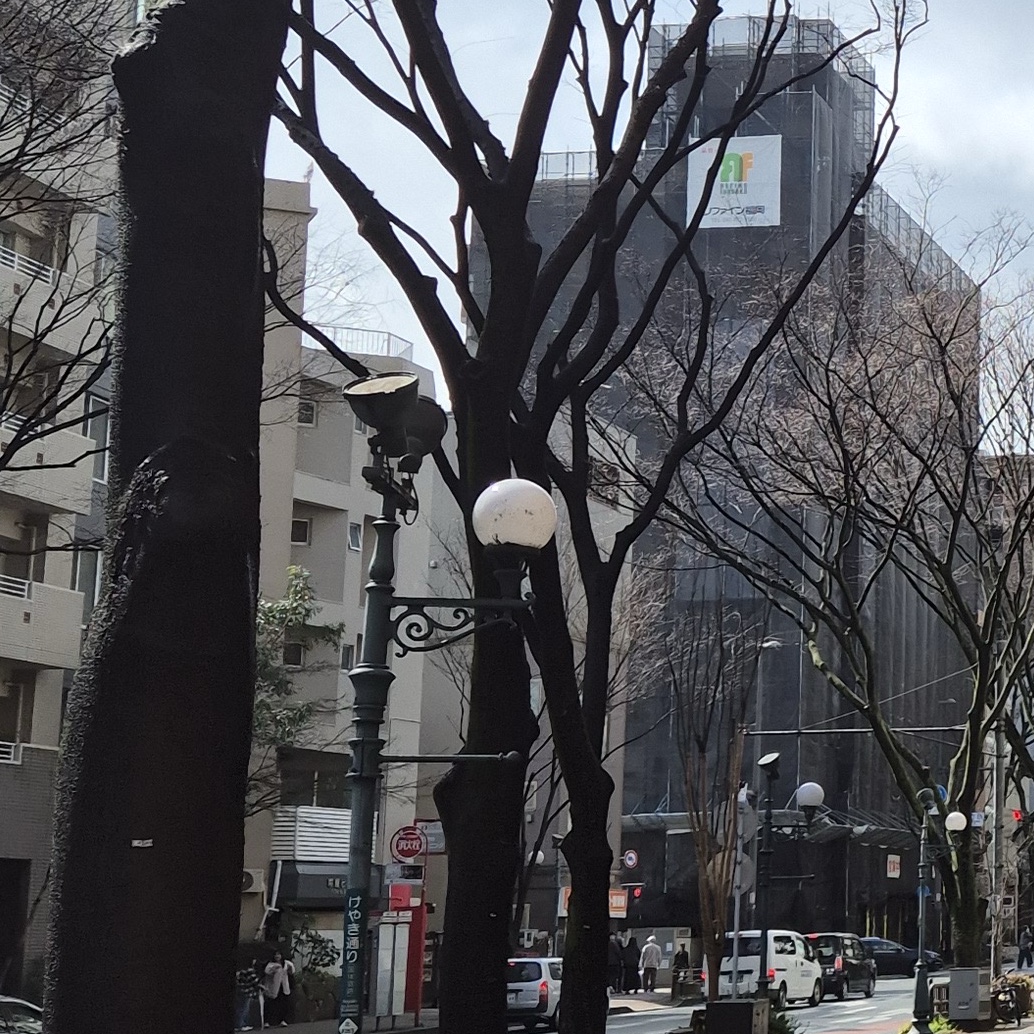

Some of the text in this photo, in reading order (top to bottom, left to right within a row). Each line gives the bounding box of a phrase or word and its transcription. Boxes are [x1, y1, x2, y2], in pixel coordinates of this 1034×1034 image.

[346, 895, 362, 963] けやき通り
